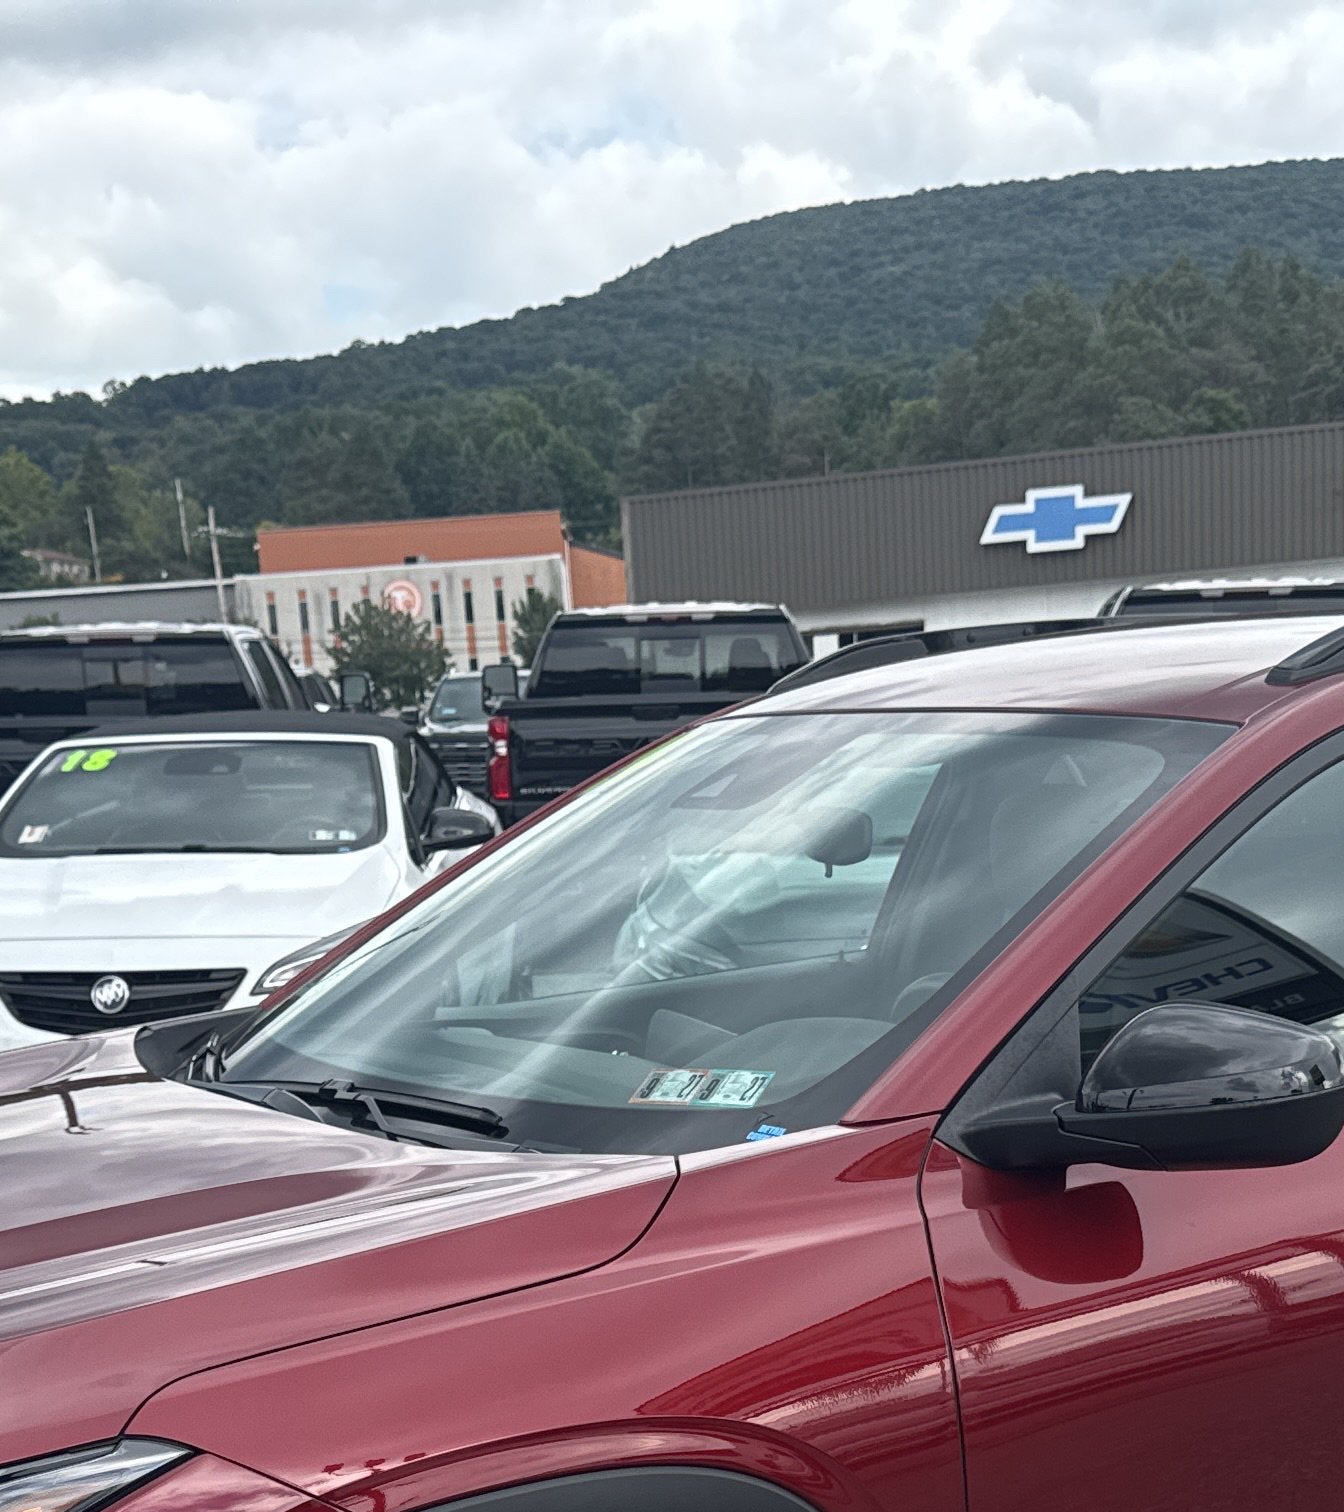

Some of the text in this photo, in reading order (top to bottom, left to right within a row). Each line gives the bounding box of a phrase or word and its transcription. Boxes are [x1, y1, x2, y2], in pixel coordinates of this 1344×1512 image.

[61, 750, 117, 771] 18
[640, 1074, 706, 1099] 9 27
[699, 1076, 768, 1102] 9 27
